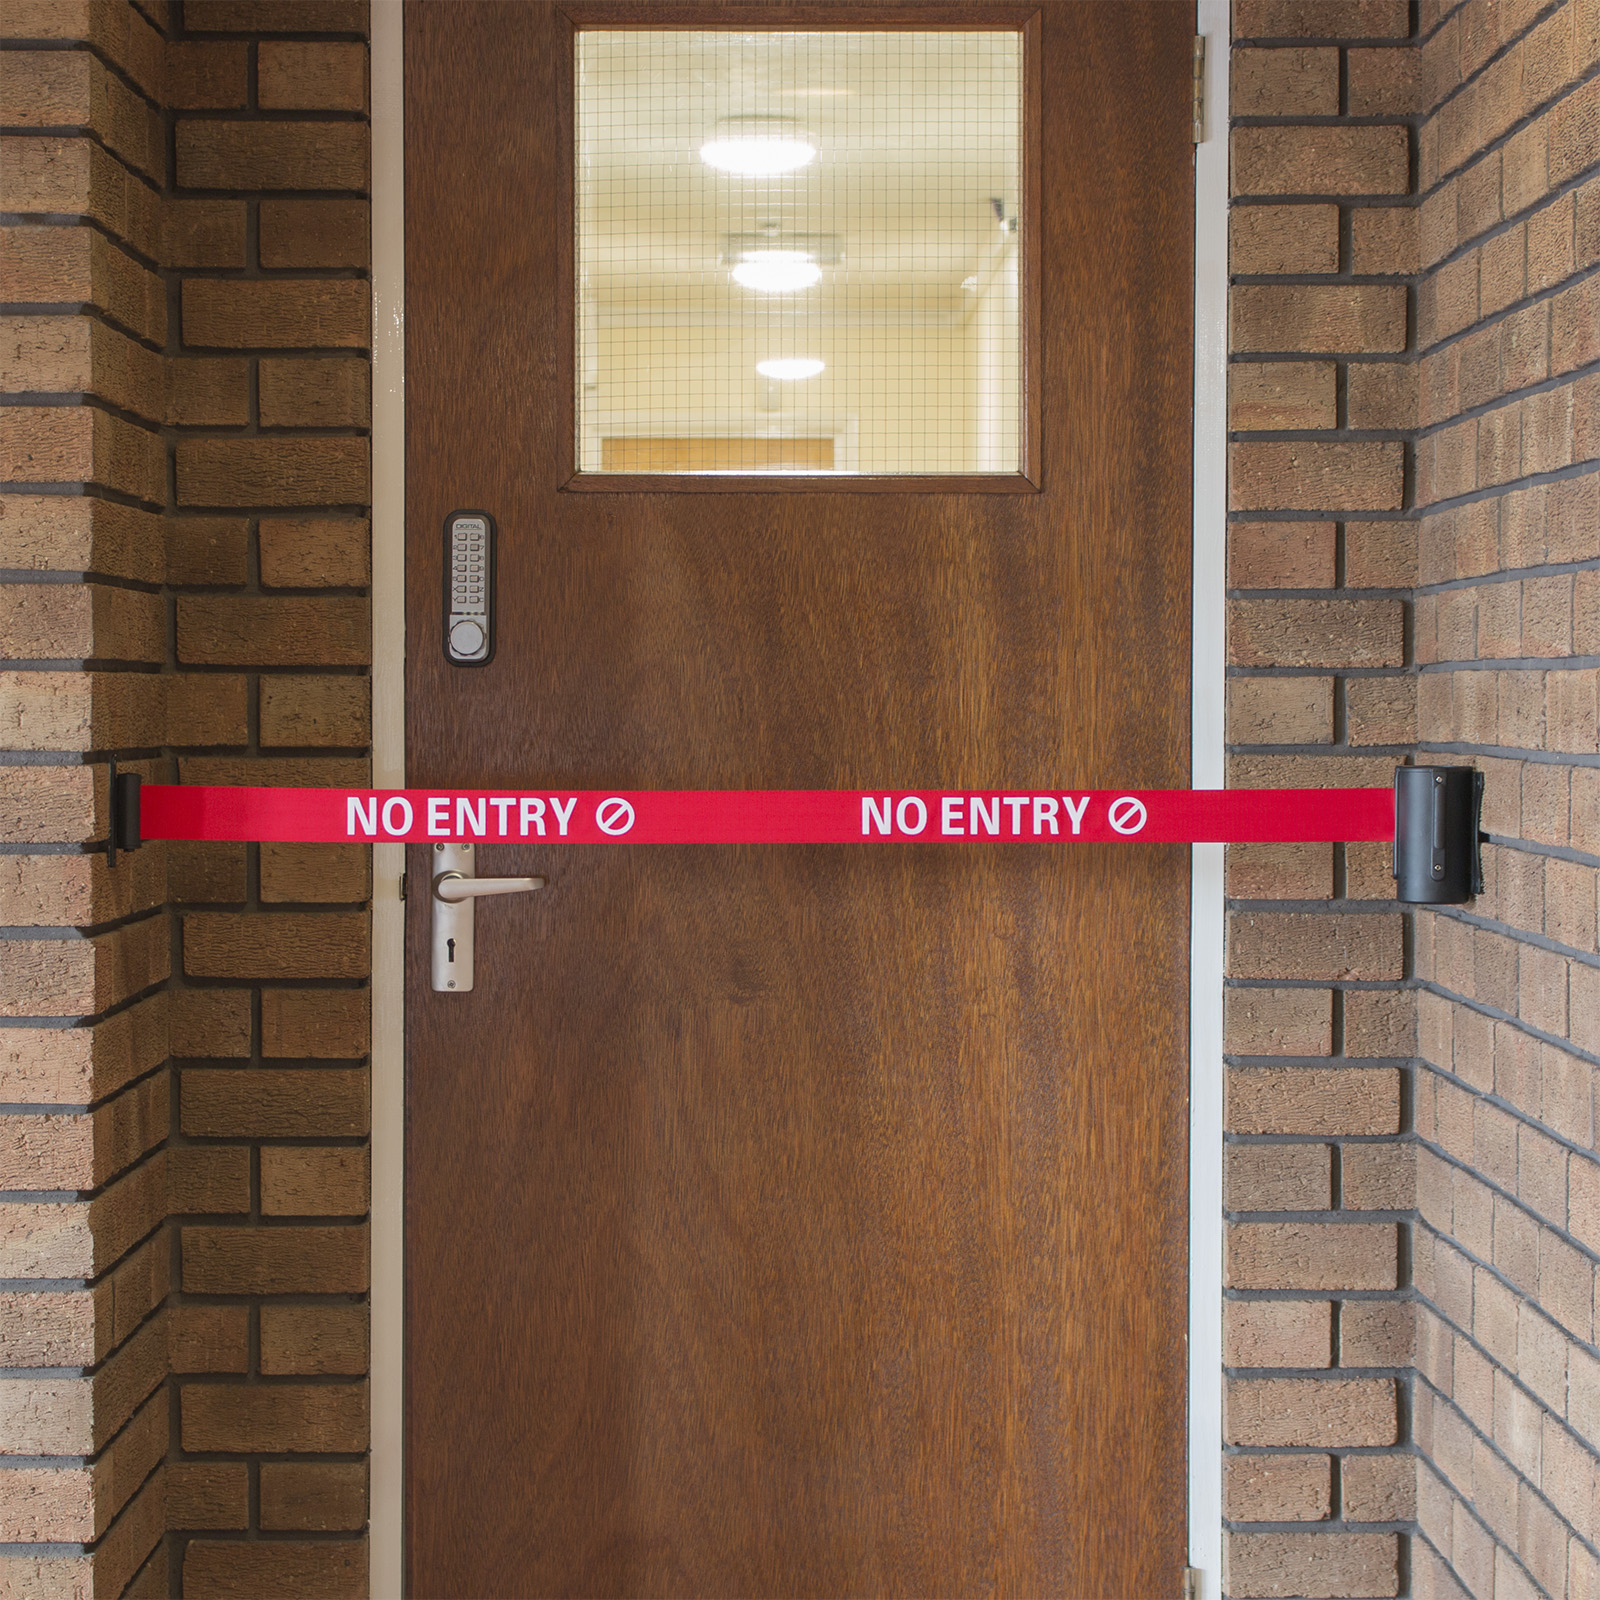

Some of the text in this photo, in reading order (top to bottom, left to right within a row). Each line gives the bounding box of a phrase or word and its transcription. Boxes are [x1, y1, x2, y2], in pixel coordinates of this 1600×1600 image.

[346, 796, 578, 836] NO ENTRY
[861, 796, 1091, 835] NO ENTRY
